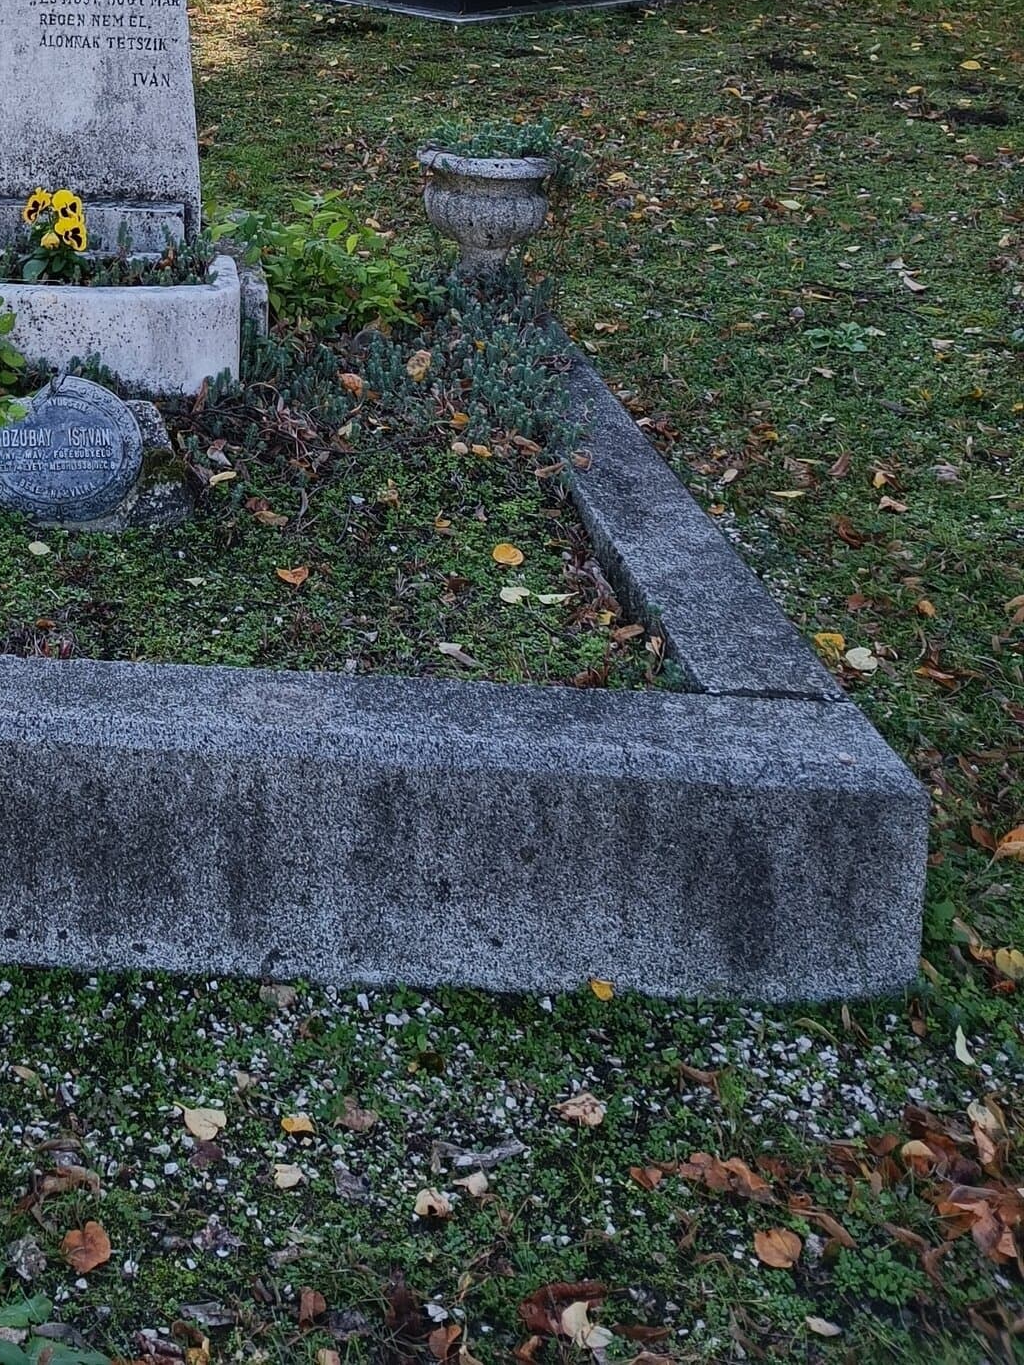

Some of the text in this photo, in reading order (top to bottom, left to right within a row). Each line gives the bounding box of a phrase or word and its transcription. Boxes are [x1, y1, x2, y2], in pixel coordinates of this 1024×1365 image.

[39, 8, 86, 27] RÉGEN
[91, 14, 124, 27] NEM
[132, 65, 170, 88] IVÁN
[2, 429, 52, 448] DZUBAY
